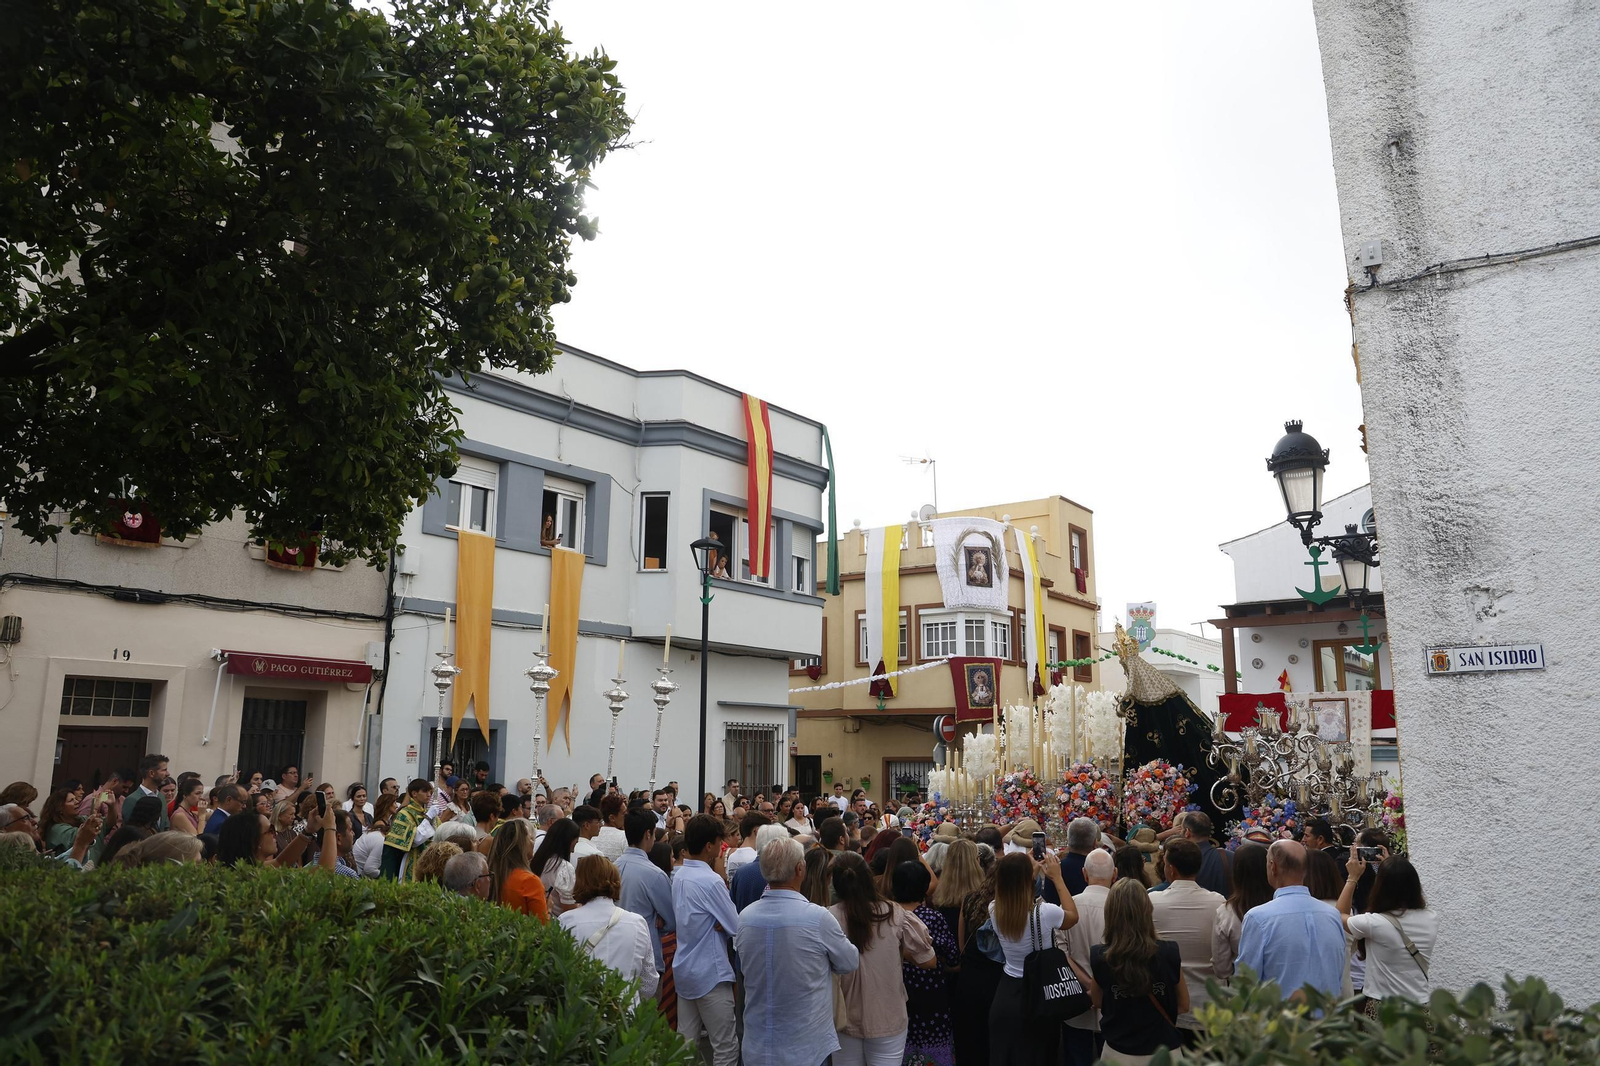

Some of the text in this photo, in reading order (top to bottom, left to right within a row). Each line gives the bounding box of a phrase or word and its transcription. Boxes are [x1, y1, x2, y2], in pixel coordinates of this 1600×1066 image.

[113, 648, 131, 661] 19
[1459, 649, 1538, 667] SAN ISIDRO
[270, 663, 353, 678] PACO GUTIÉRREZ
[1043, 980, 1083, 1000] MOSCHINO
